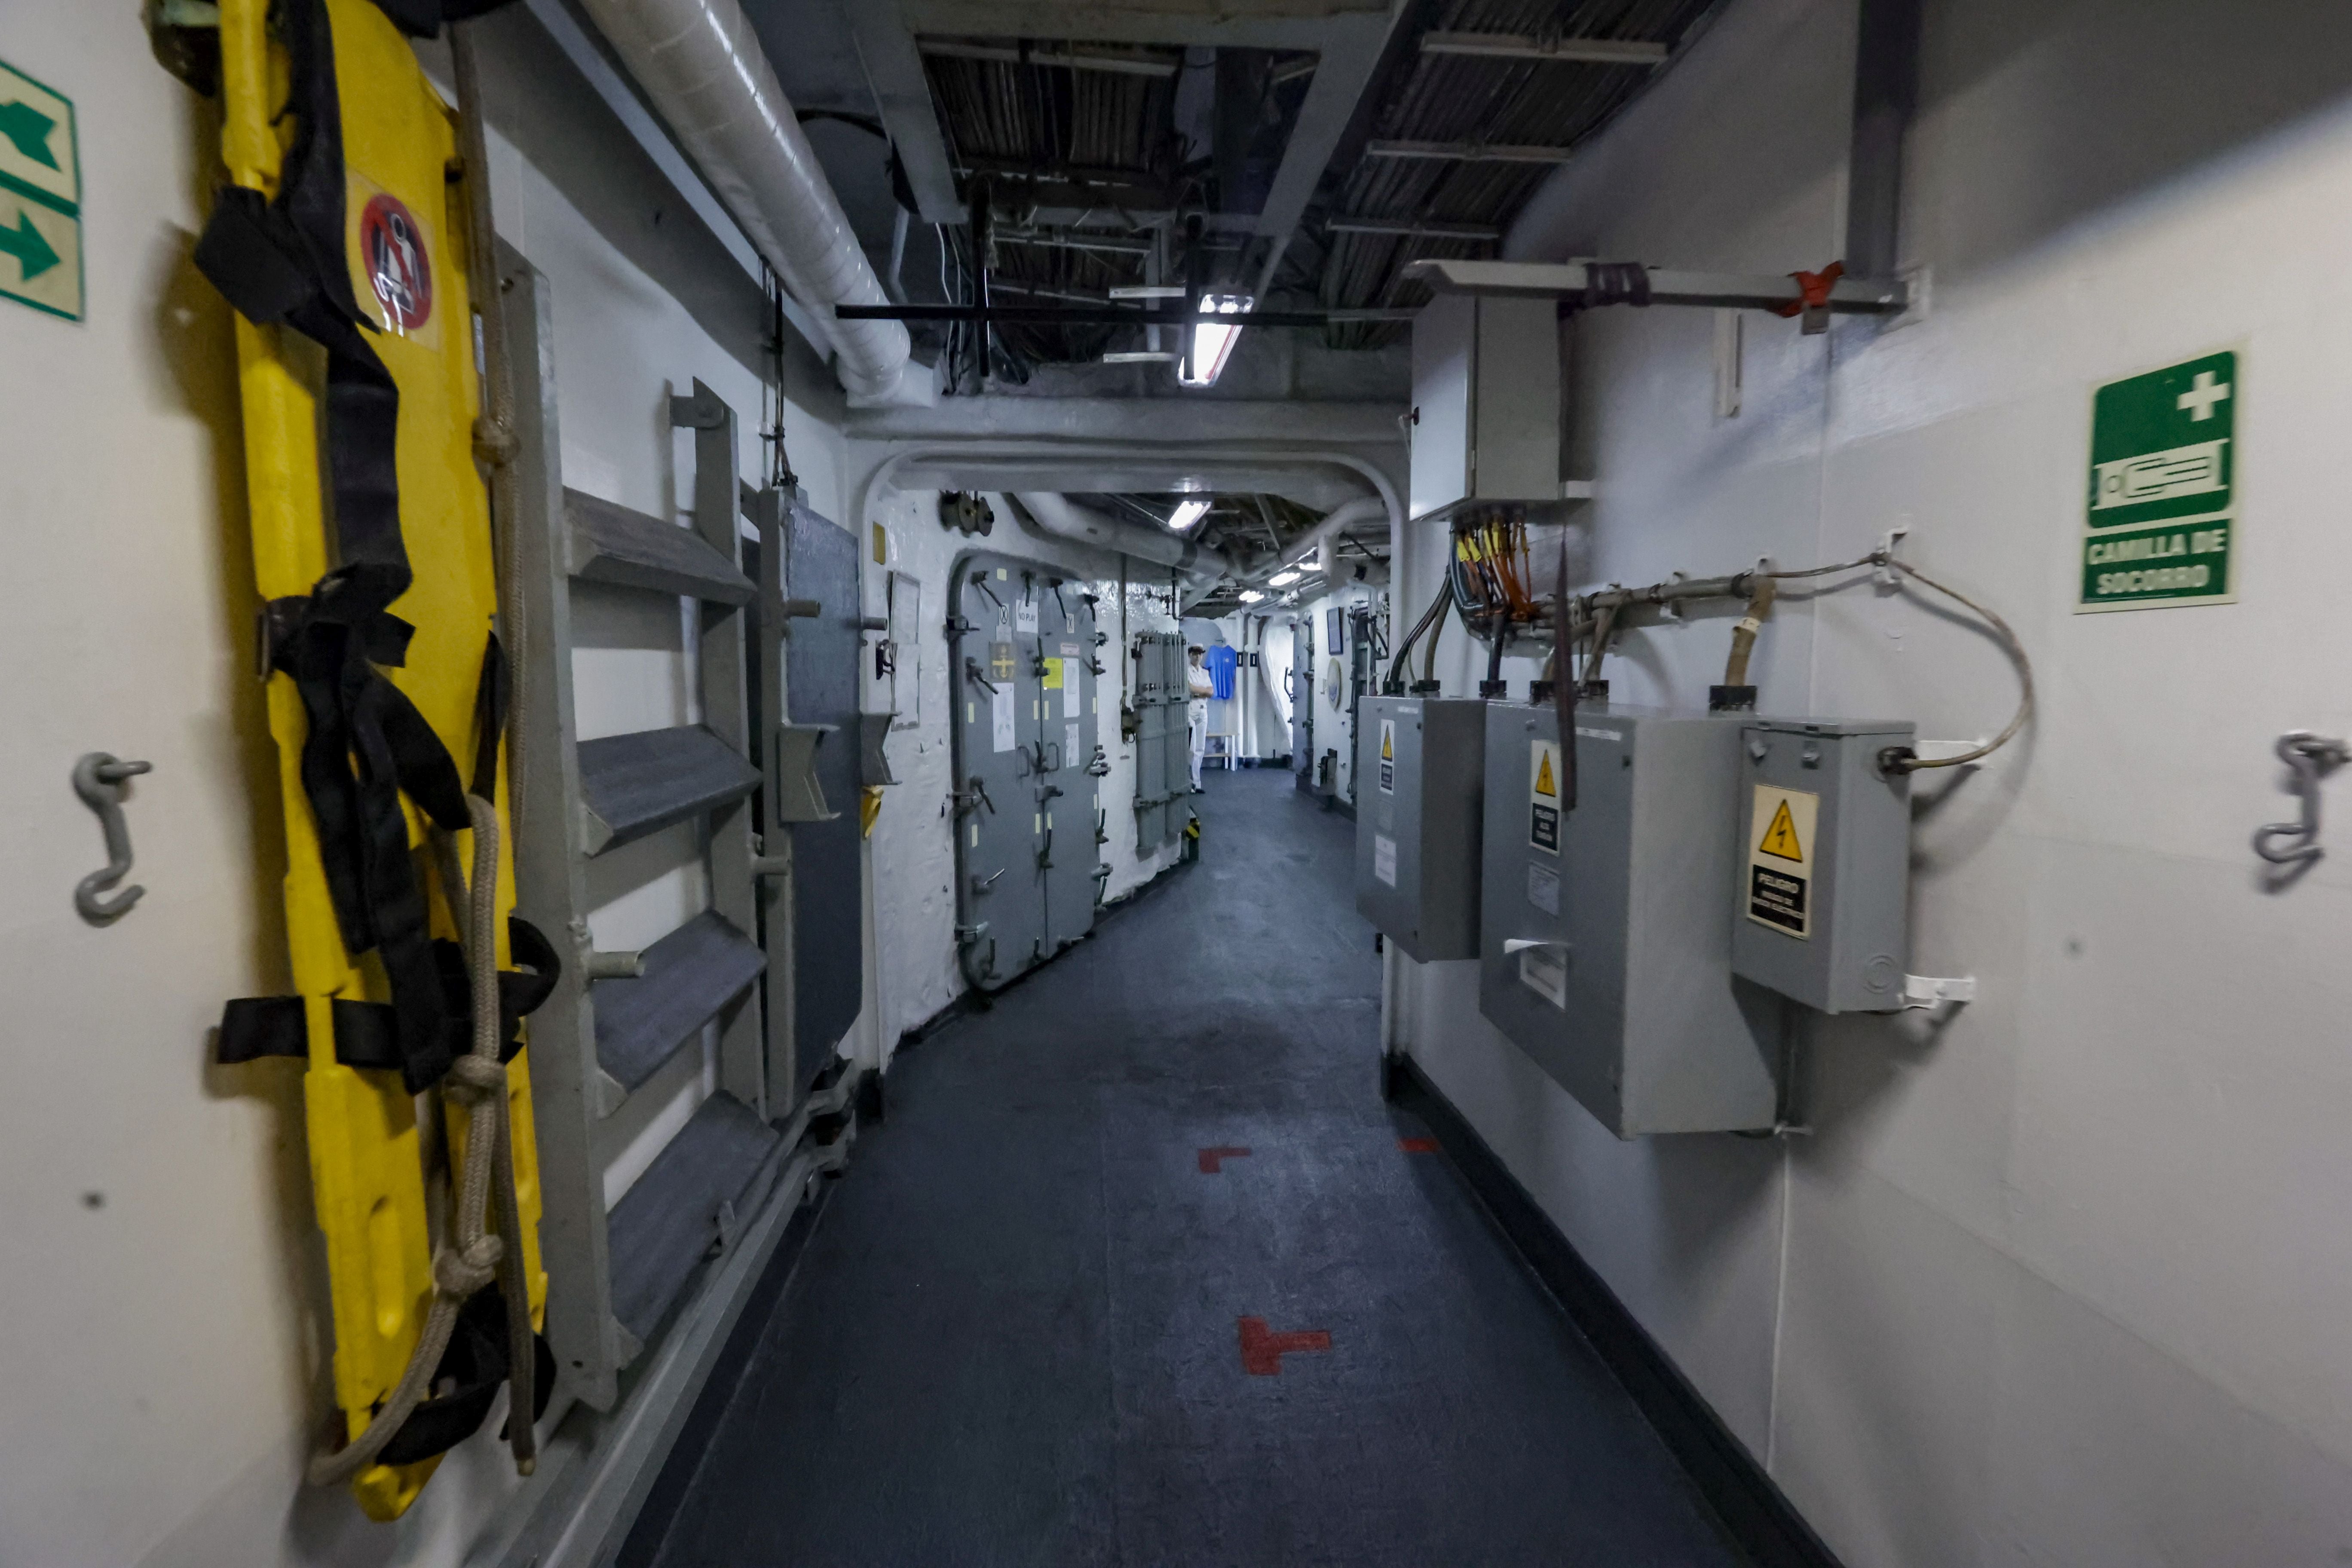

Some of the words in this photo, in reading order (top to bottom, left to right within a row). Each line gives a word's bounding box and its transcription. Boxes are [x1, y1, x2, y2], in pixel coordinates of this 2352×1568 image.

[2088, 533, 2187, 565] CAMILLA
[2191, 528, 2226, 554] DE
[2096, 564, 2209, 595] SOCORRO
[1758, 873, 1799, 894] PELIGRO
